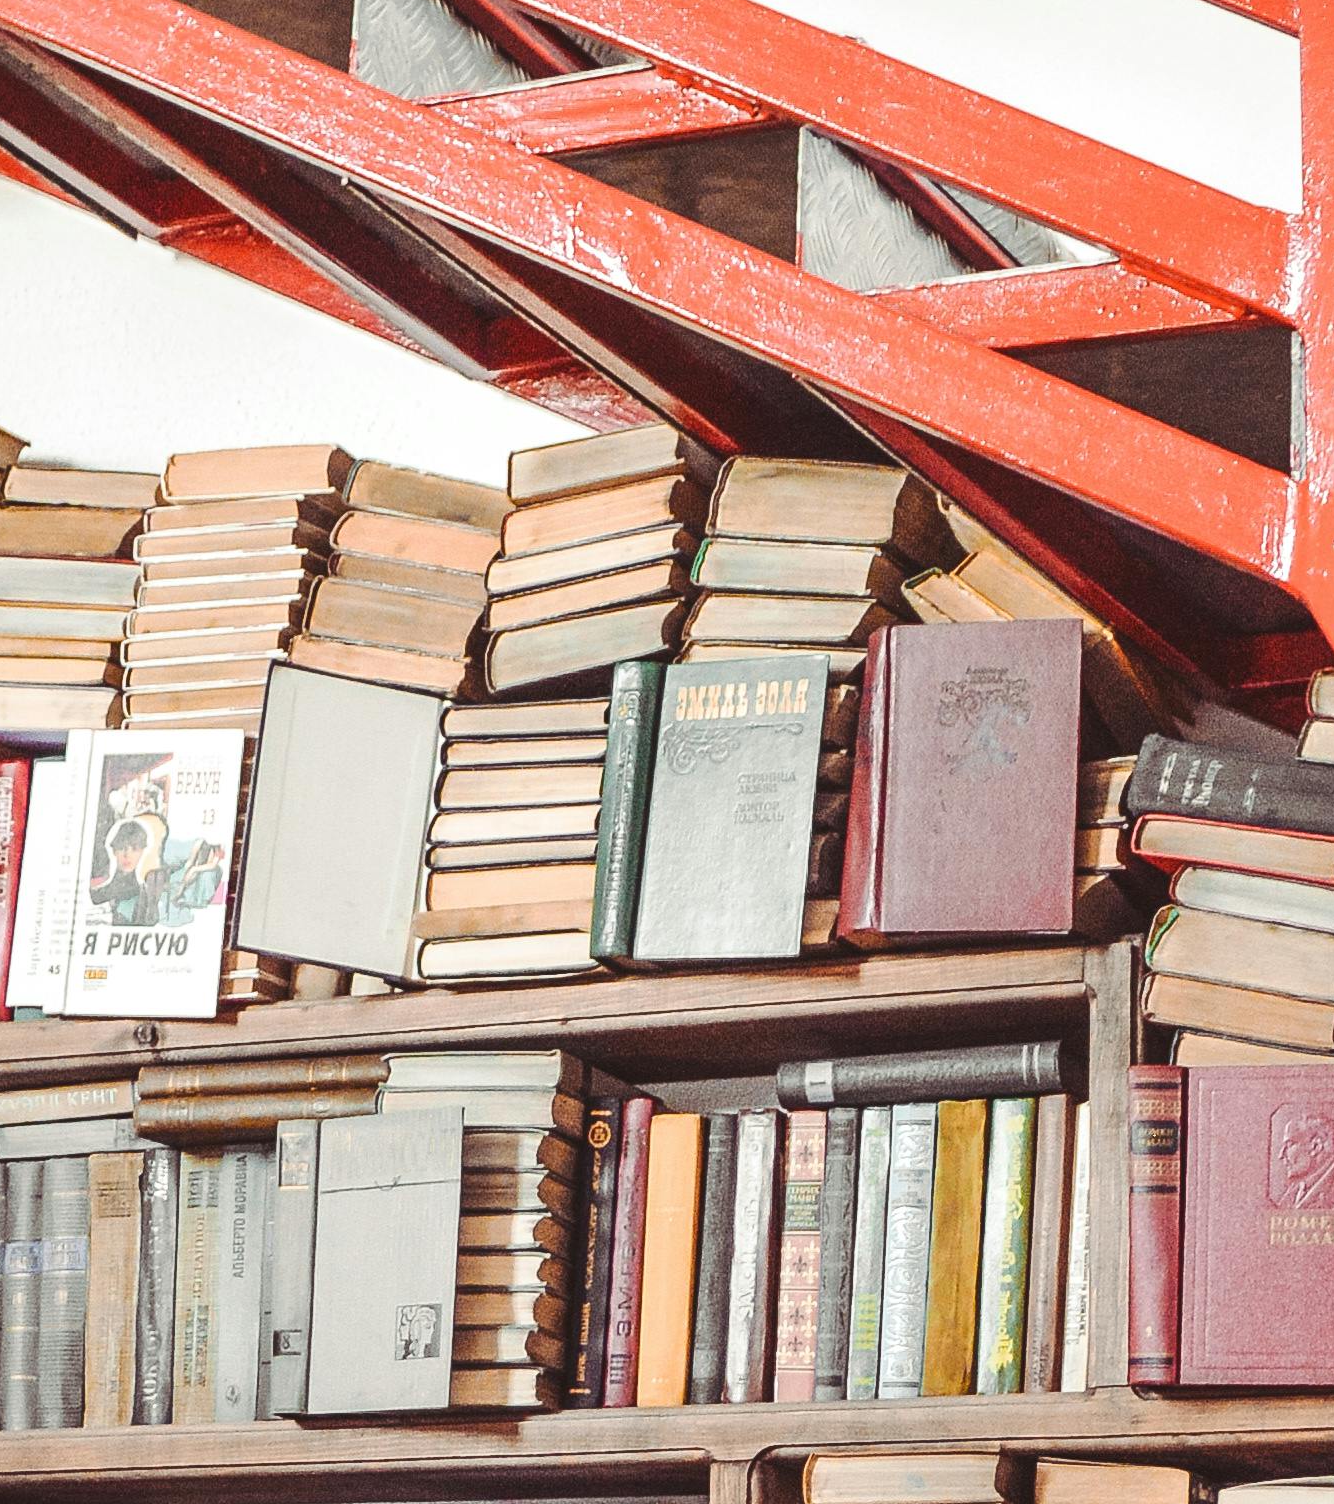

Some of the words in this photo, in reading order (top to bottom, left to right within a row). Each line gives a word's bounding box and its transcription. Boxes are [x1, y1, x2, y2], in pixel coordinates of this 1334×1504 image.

[676, 681, 749, 720] ЭМИЛЬ
[755, 679, 810, 716] ЗОЛЯ
[175, 771, 221, 795] БРАУН
[83, 932, 98, 956] Я
[107, 933, 189, 957] РИСУЮ
[67, 1088, 118, 1106] КЕНТ
[234, 1155, 248, 1214] МОРАВИА
[232, 1218, 246, 1278] АЛЬБЕРТО
